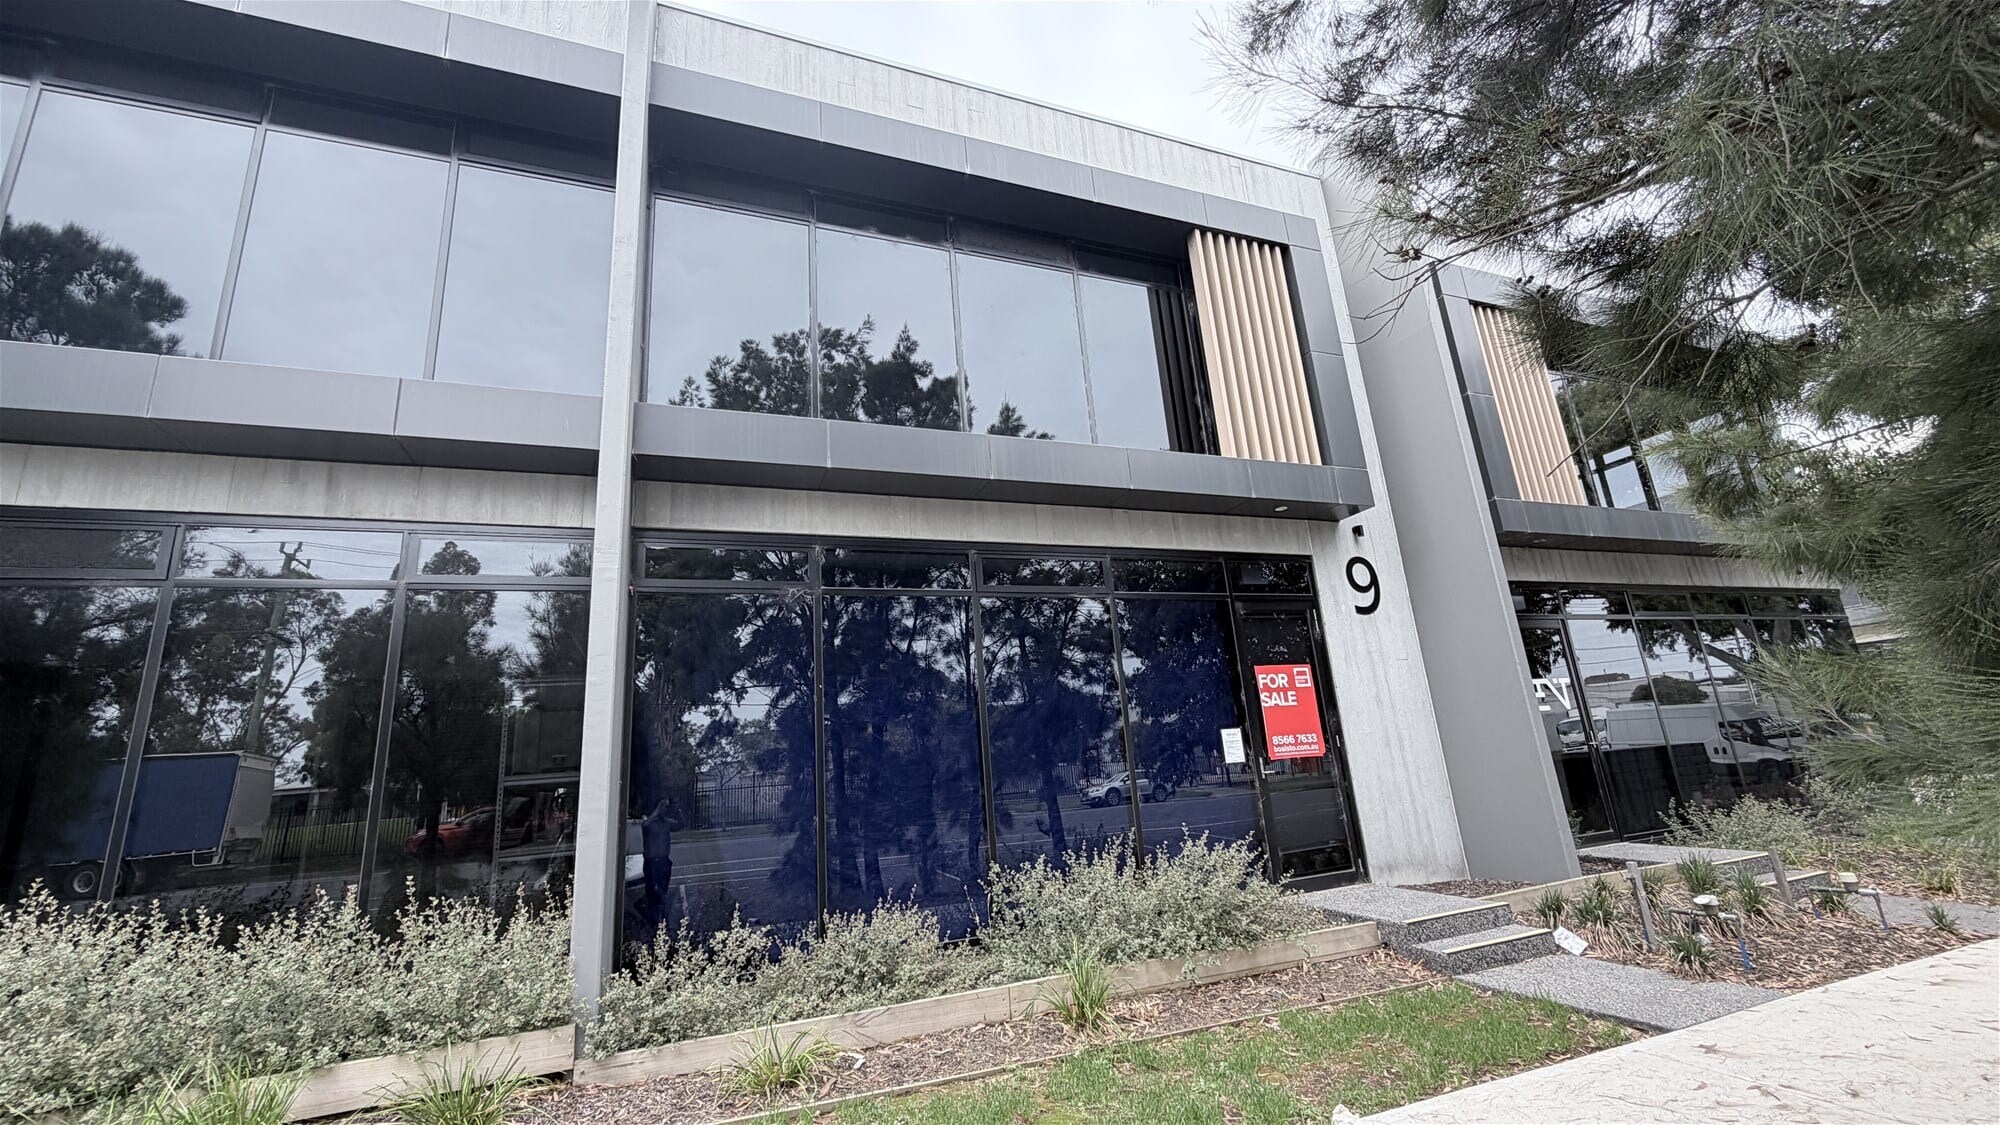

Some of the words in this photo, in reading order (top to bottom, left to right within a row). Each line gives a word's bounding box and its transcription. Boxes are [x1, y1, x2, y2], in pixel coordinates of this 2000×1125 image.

[1346, 556, 1380, 615] 9
[1258, 673, 1289, 689] FOR
[1261, 691, 1297, 707] SALE
[1272, 735, 1295, 745] 8566
[1295, 733, 1318, 743] 7633
[1273, 744, 1319, 753] bosisto.com.au
